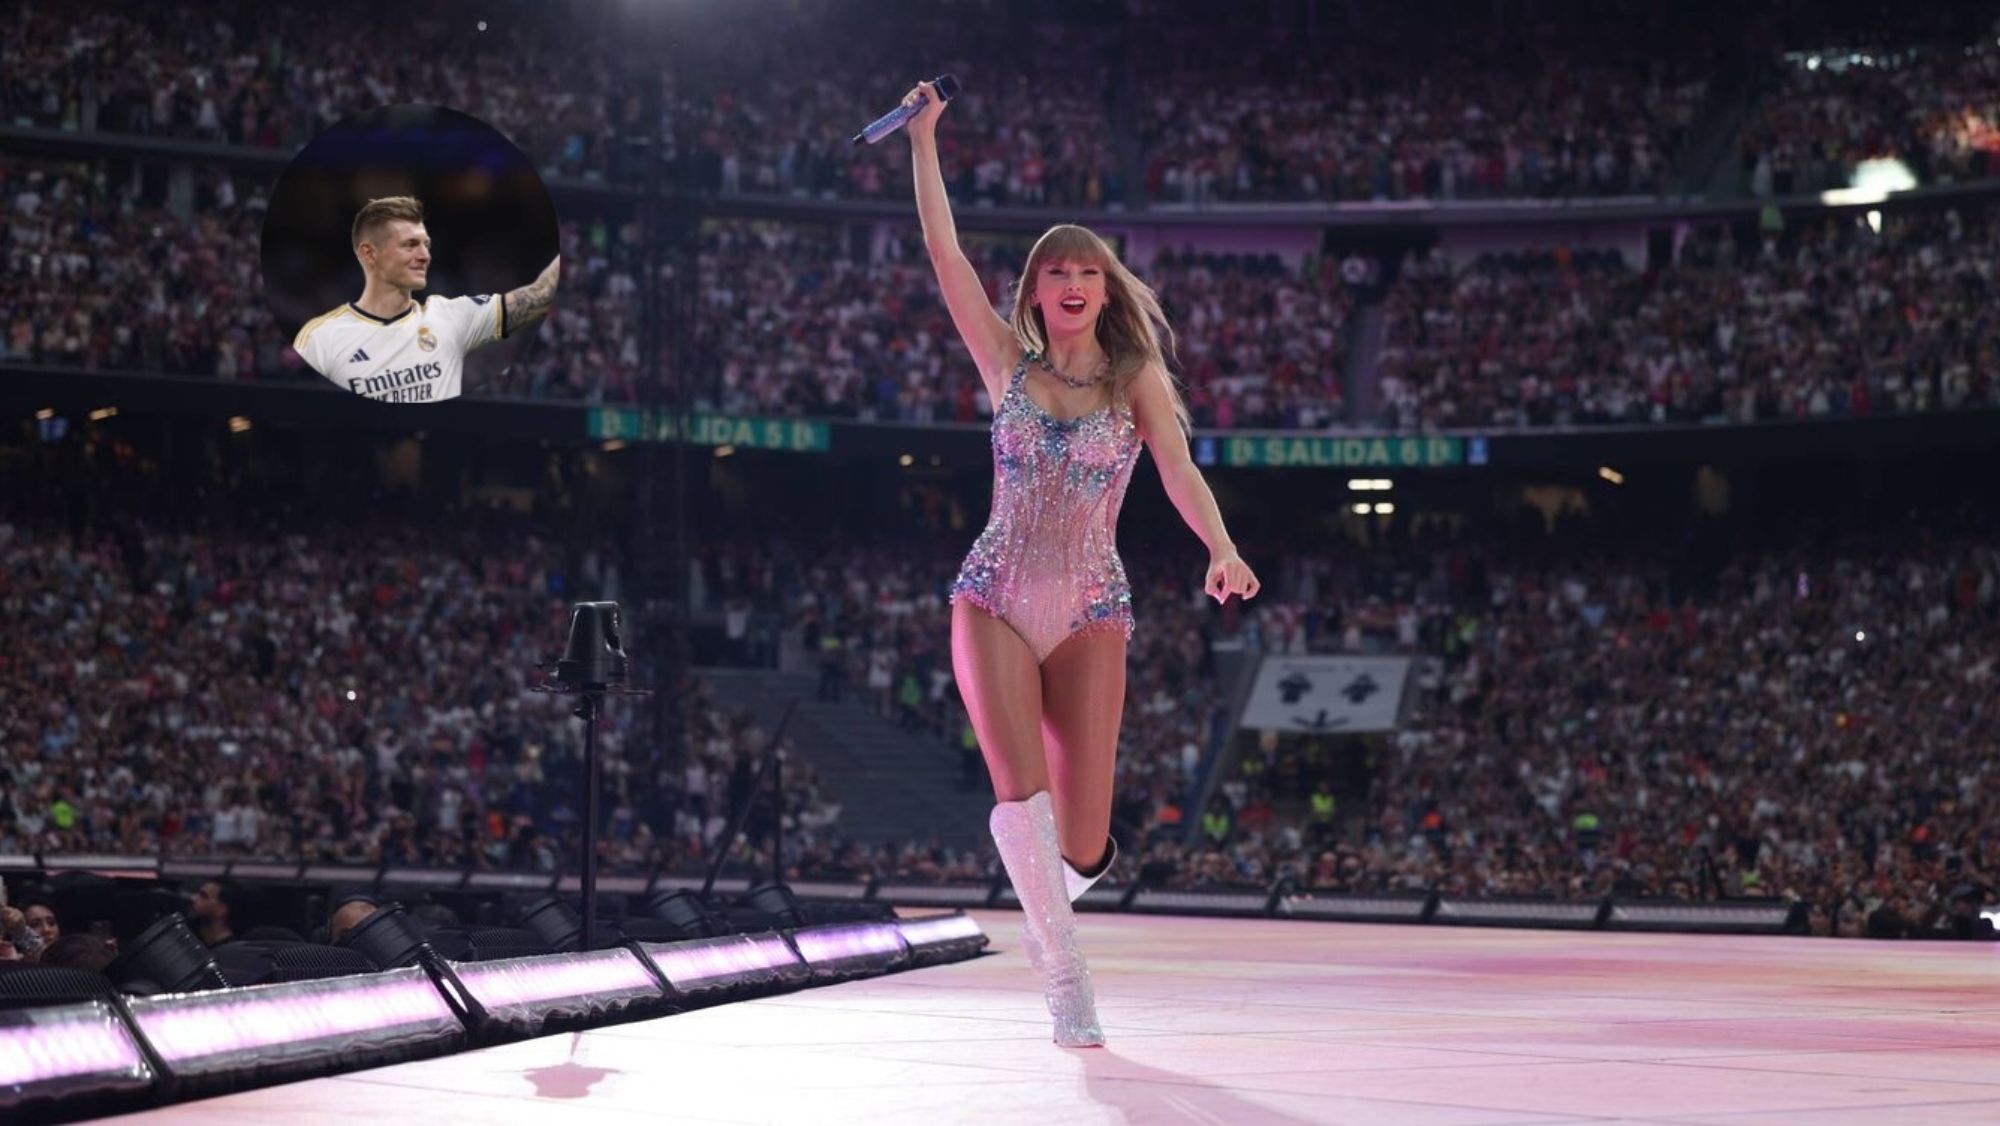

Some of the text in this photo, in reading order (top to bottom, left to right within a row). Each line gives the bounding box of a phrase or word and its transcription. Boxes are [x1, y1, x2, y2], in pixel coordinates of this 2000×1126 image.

[347, 361, 442, 397] Emirates
[393, 383, 432, 403] BETTER
[1264, 439, 1420, 466] SALIDA 6
